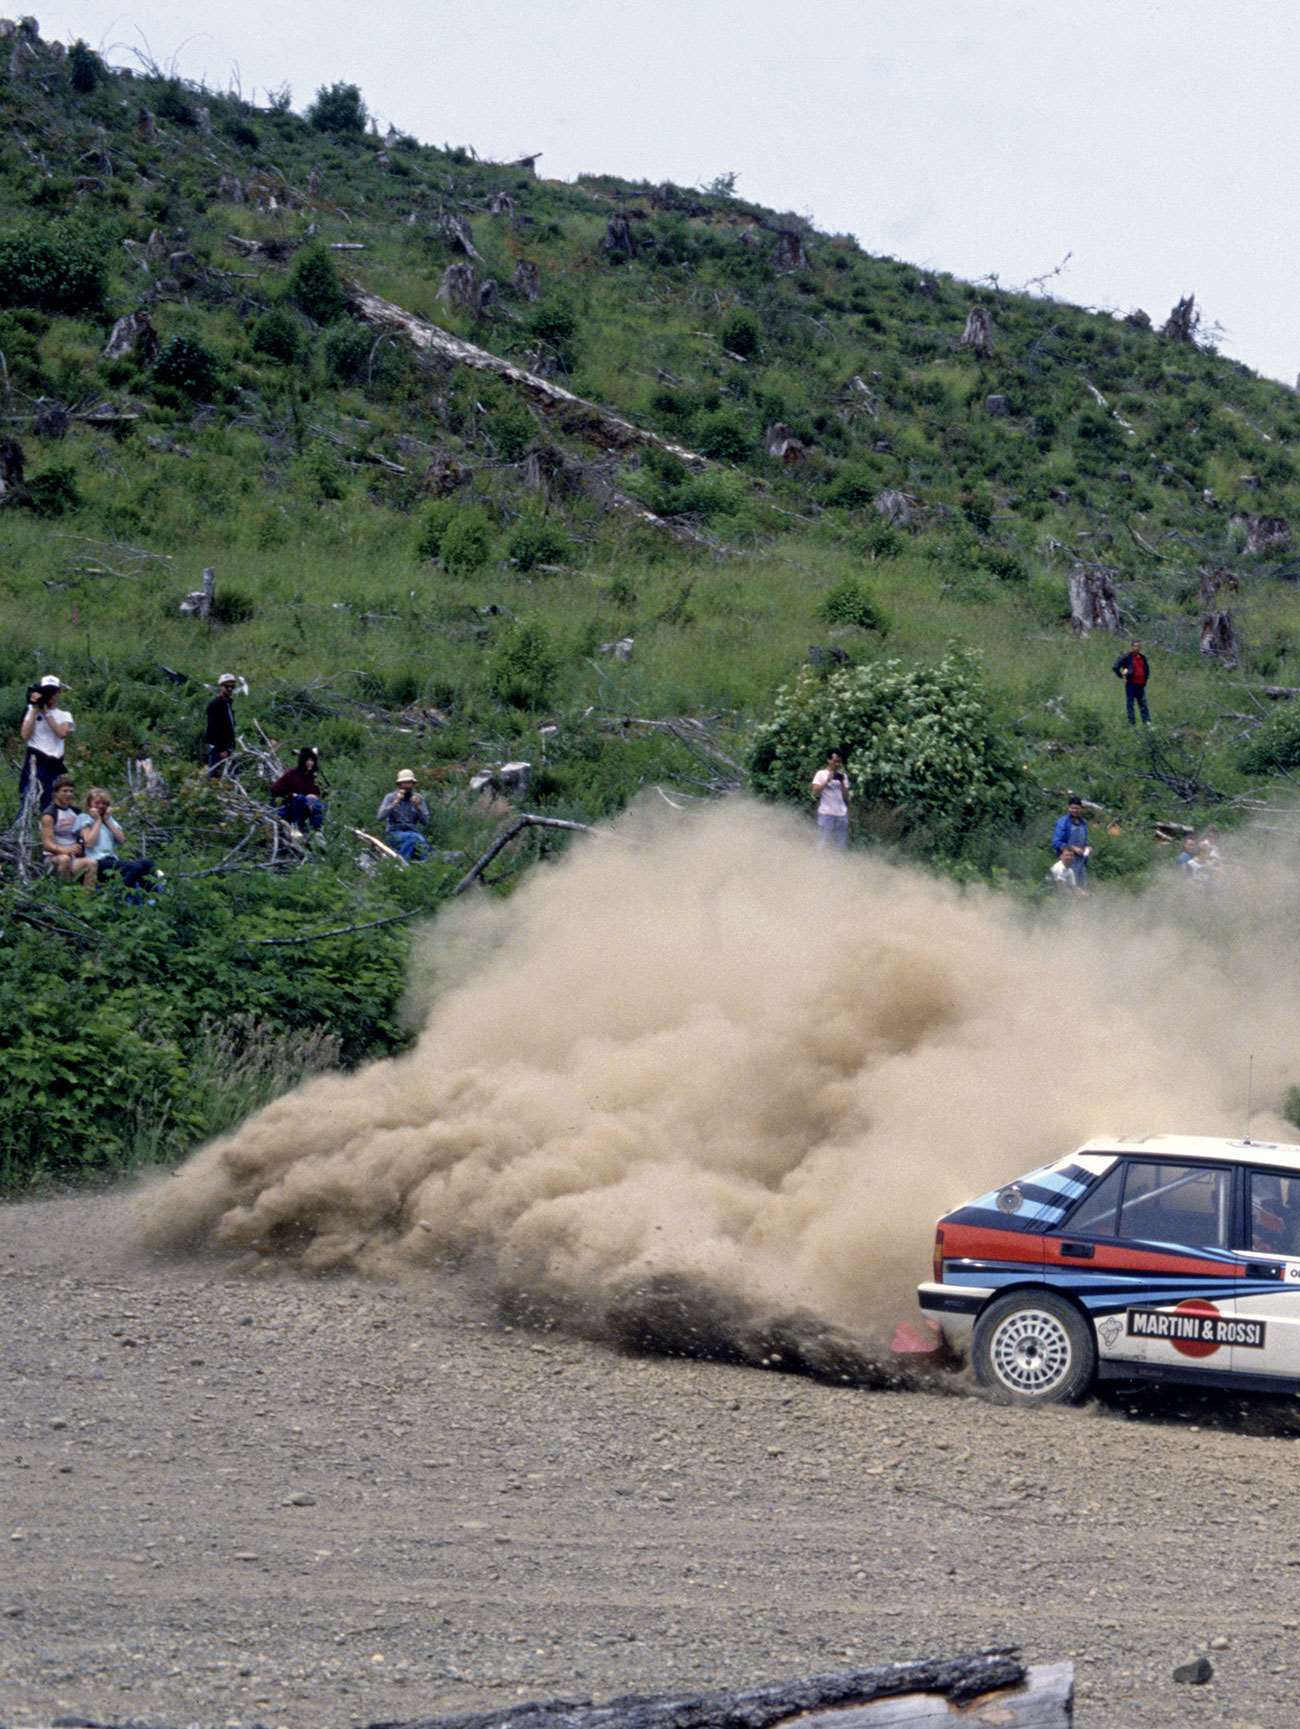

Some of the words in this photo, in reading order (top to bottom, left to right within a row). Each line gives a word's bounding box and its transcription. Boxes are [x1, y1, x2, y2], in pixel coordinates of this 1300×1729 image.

[1133, 1313, 1198, 1338] MARTINI
[1201, 1318, 1214, 1340] &
[1217, 1321, 1260, 1344] ROSSI
